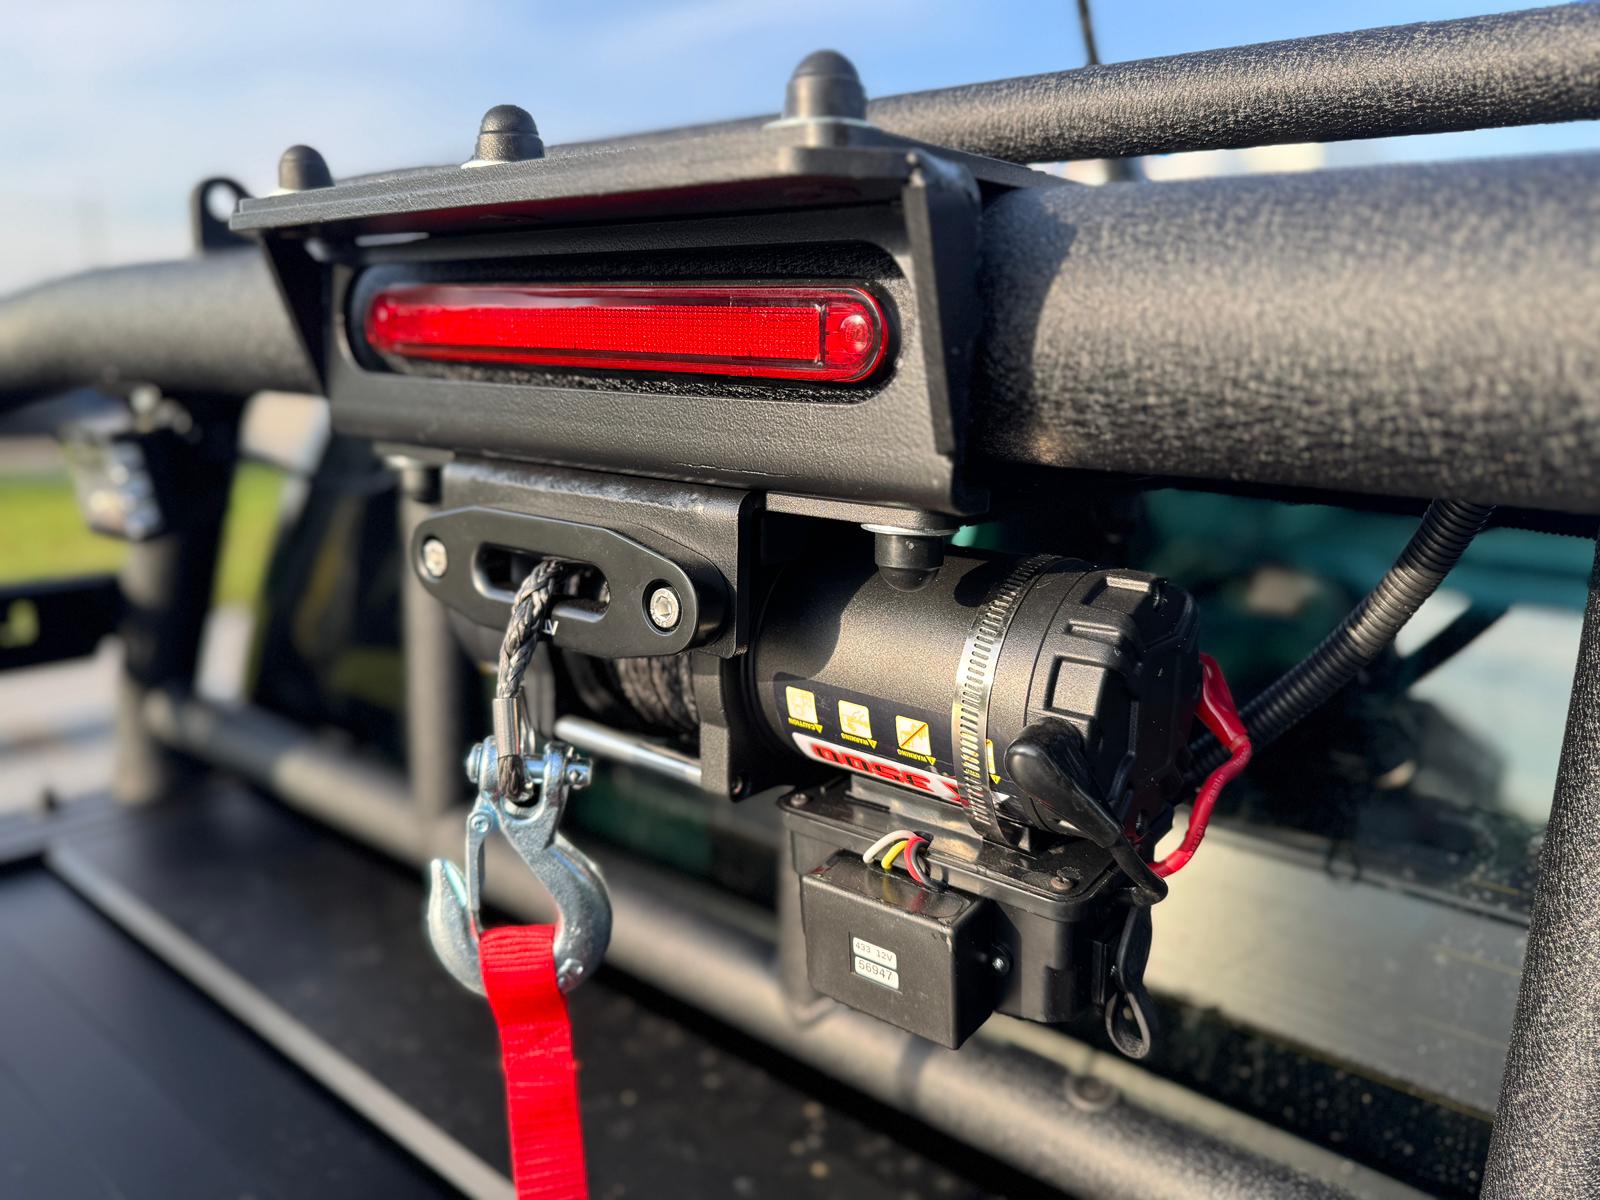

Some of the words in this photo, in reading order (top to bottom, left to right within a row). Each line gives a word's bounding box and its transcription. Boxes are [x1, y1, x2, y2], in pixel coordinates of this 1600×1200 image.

[788, 717, 816, 730] CAUTION
[841, 732, 869, 745] WARNING
[896, 749, 928, 762] WARNING
[855, 942, 871, 953] 433
[876, 950, 893, 961] 12V
[858, 959, 892, 980] 56947
